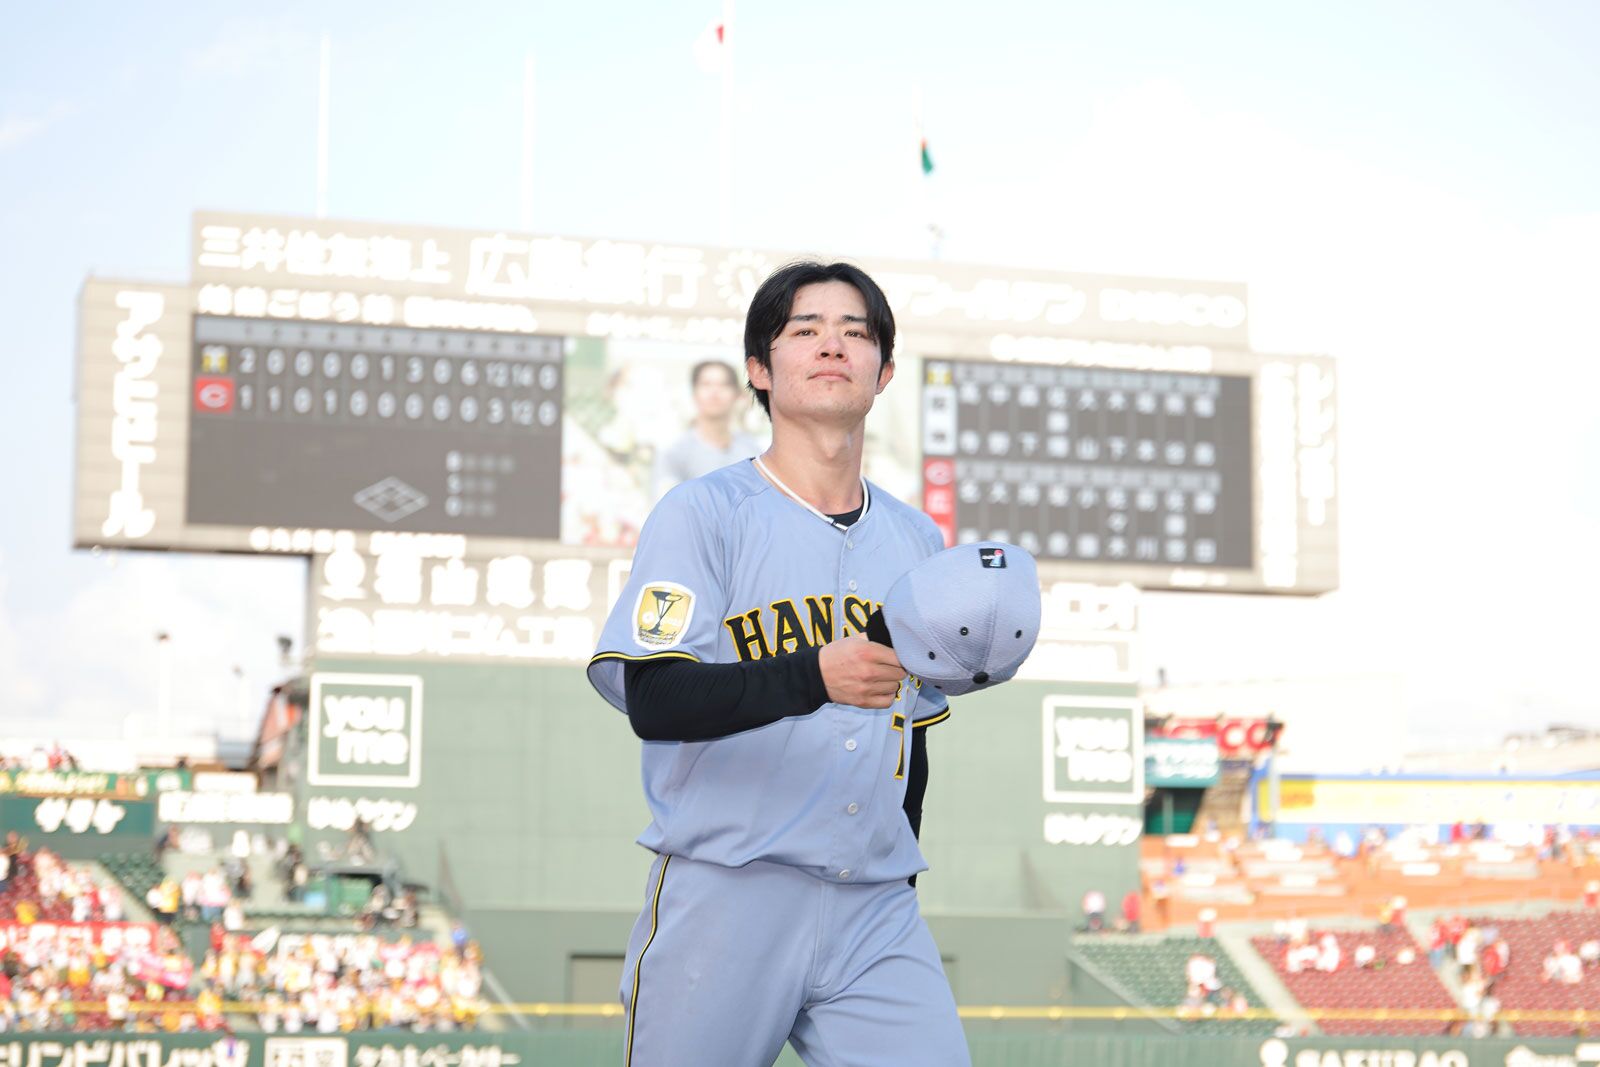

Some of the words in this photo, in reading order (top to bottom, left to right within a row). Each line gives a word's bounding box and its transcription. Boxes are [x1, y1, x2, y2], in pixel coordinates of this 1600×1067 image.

[240, 348, 254, 372] 2
[268, 350, 284, 374] 0
[295, 352, 312, 375] 0
[324, 353, 340, 377] 0
[351, 355, 368, 379] 0
[382, 356, 393, 379] 1
[408, 358, 423, 382] 3
[434, 359, 451, 383] 0
[461, 361, 478, 385] 6
[539, 365, 557, 389] 0
[240, 385, 251, 409] 1
[269, 386, 280, 410] 1
[294, 388, 311, 412] 0
[325, 389, 337, 412] 1
[350, 391, 367, 415] 0
[378, 392, 395, 417] 0
[405, 394, 423, 418] 0
[433, 396, 450, 420] 0
[460, 397, 478, 421] 0
[488, 398, 504, 421] 3
[538, 401, 557, 425] 0
[323, 695, 405, 738] you
[337, 730, 409, 765] me
